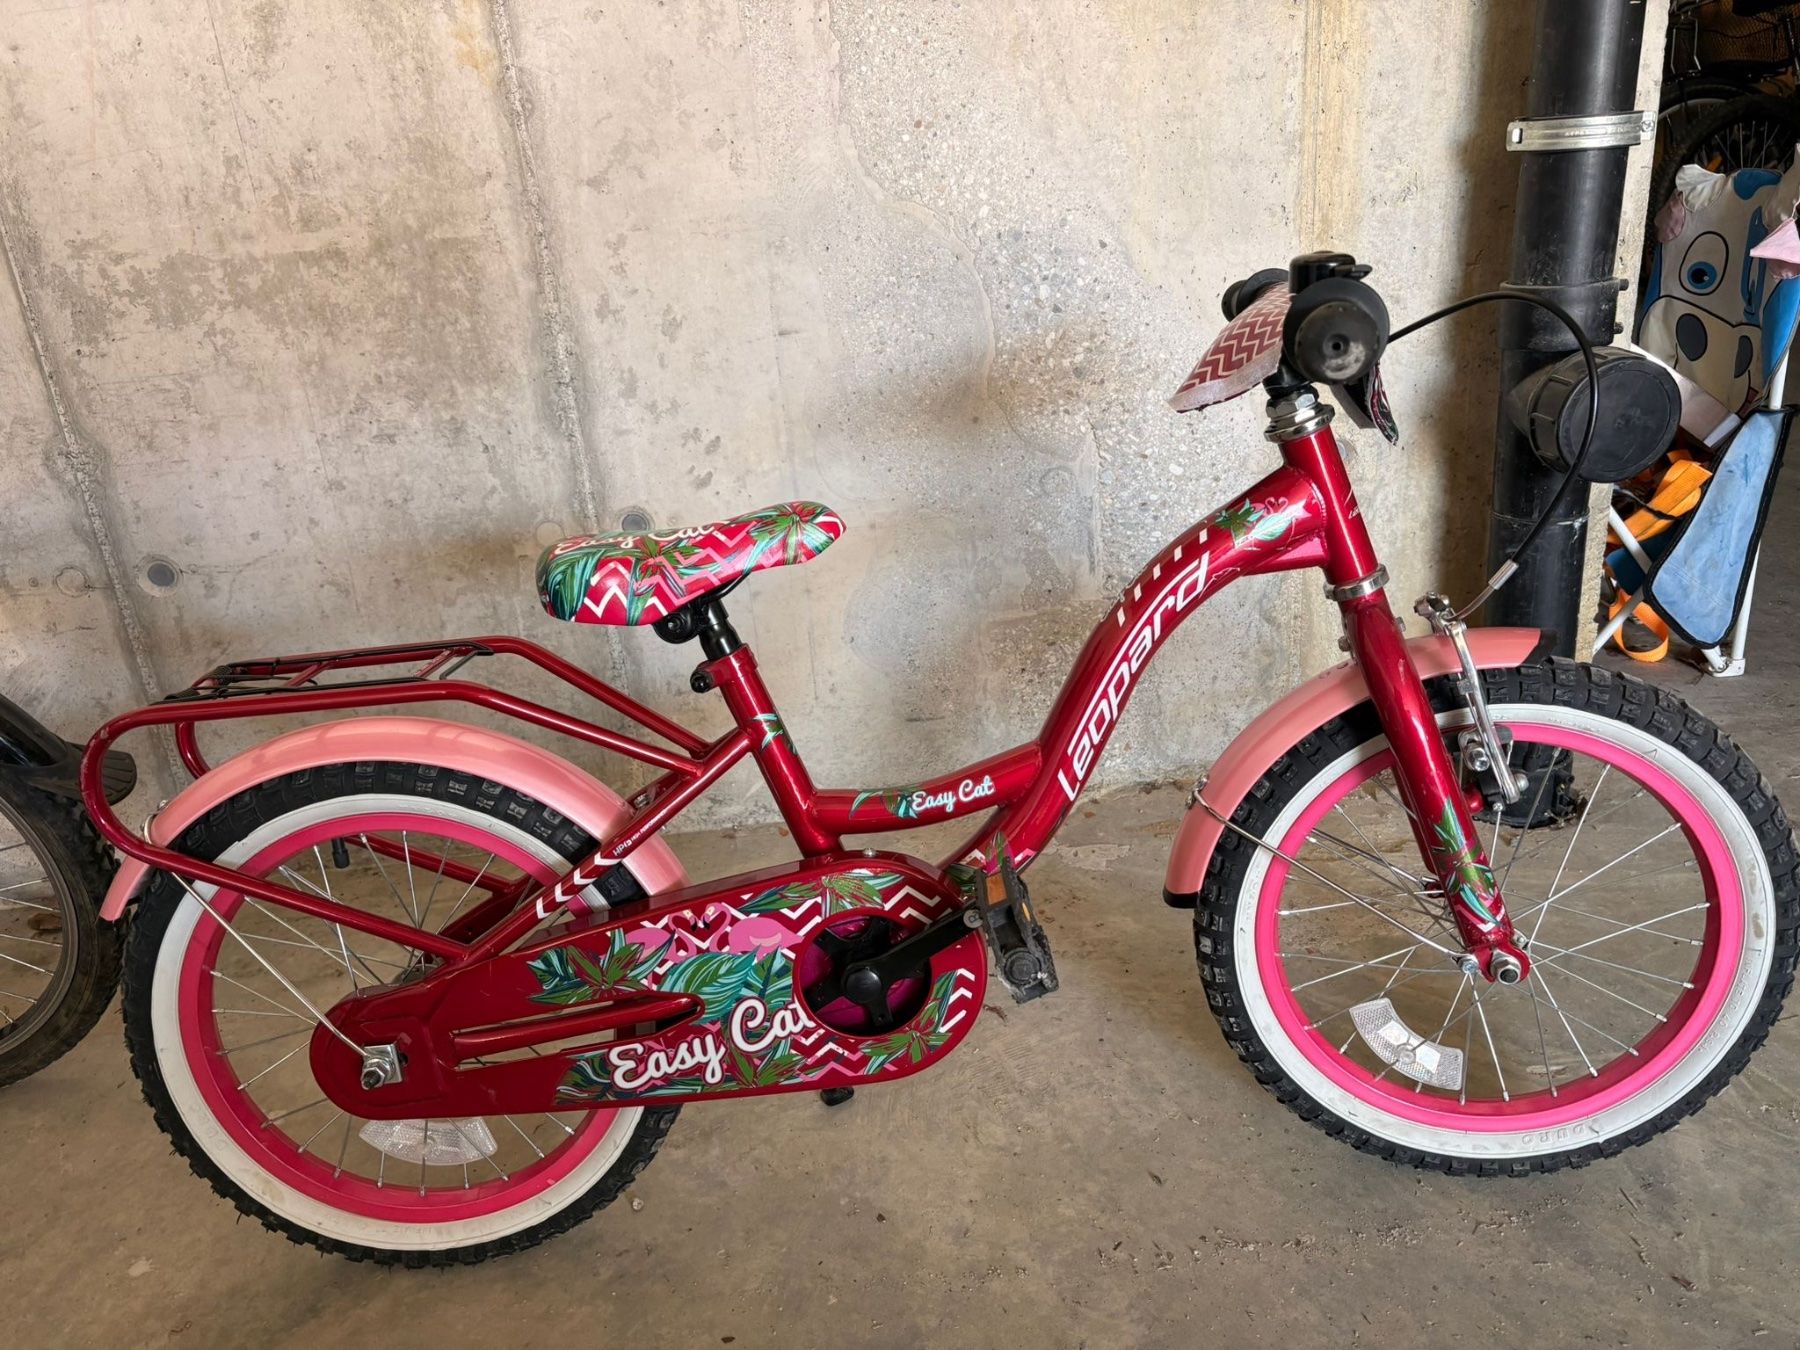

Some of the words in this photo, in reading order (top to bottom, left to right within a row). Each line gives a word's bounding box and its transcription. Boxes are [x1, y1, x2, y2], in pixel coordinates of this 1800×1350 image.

[1057, 551, 1210, 802] Leopard
[911, 790, 957, 813] Easy
[958, 775, 996, 802] Cat
[607, 1032, 728, 1091] Easy
[729, 995, 818, 1054] Cat
